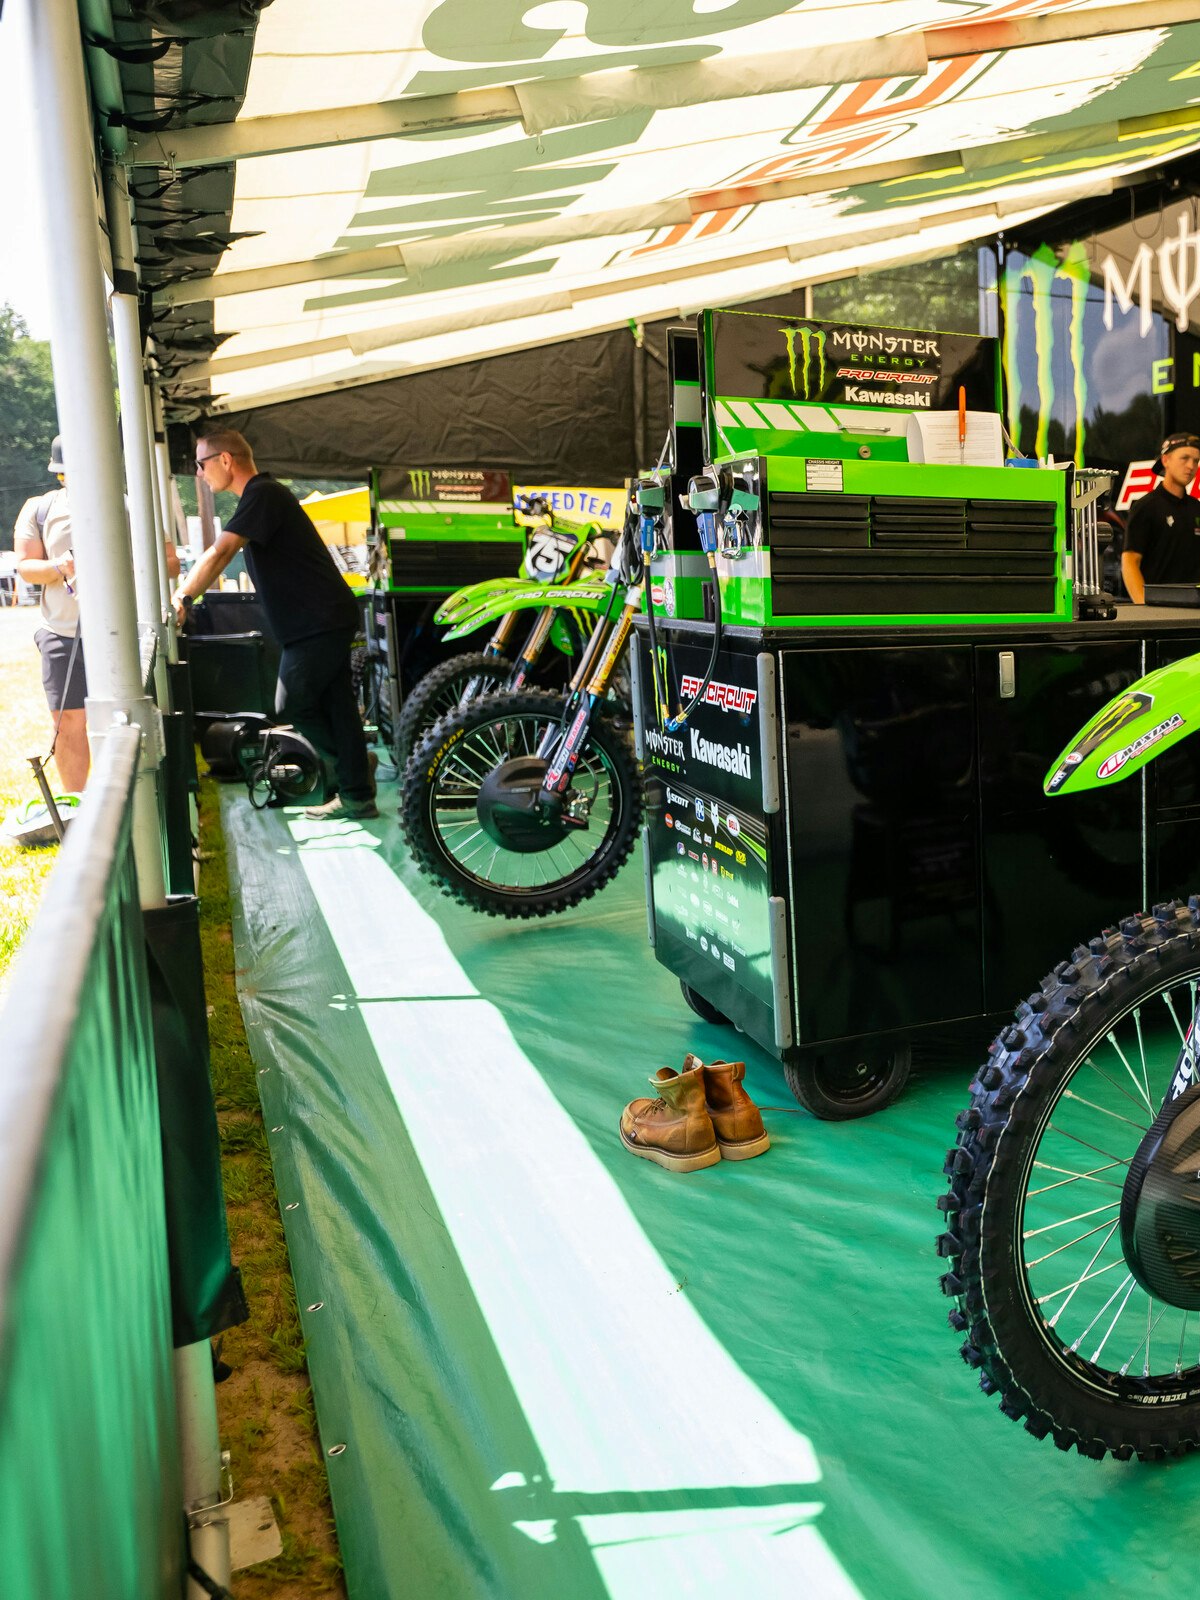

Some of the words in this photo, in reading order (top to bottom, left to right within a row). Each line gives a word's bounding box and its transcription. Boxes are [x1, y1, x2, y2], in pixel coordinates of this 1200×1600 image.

[832, 331, 941, 357] MONSTER
[850, 354, 926, 367] ENERGY
[836, 368, 874, 380] PRO
[873, 371, 938, 384] CIRCUIT
[845, 386, 931, 407] Kawasaki
[579, 493, 612, 519] TEA
[525, 533, 576, 582] 75
[545, 591, 605, 599] CIRCUIT
[706, 681, 757, 714] CIRCUIT
[645, 728, 685, 761] MONSTER
[690, 727, 751, 779] Kawasaki
[651, 755, 680, 773] ENERGY
[670, 794, 689, 808] SCOTT
[1142, 1395, 1160, 1404] A60
[1160, 1392, 1187, 1403] EXCEL
